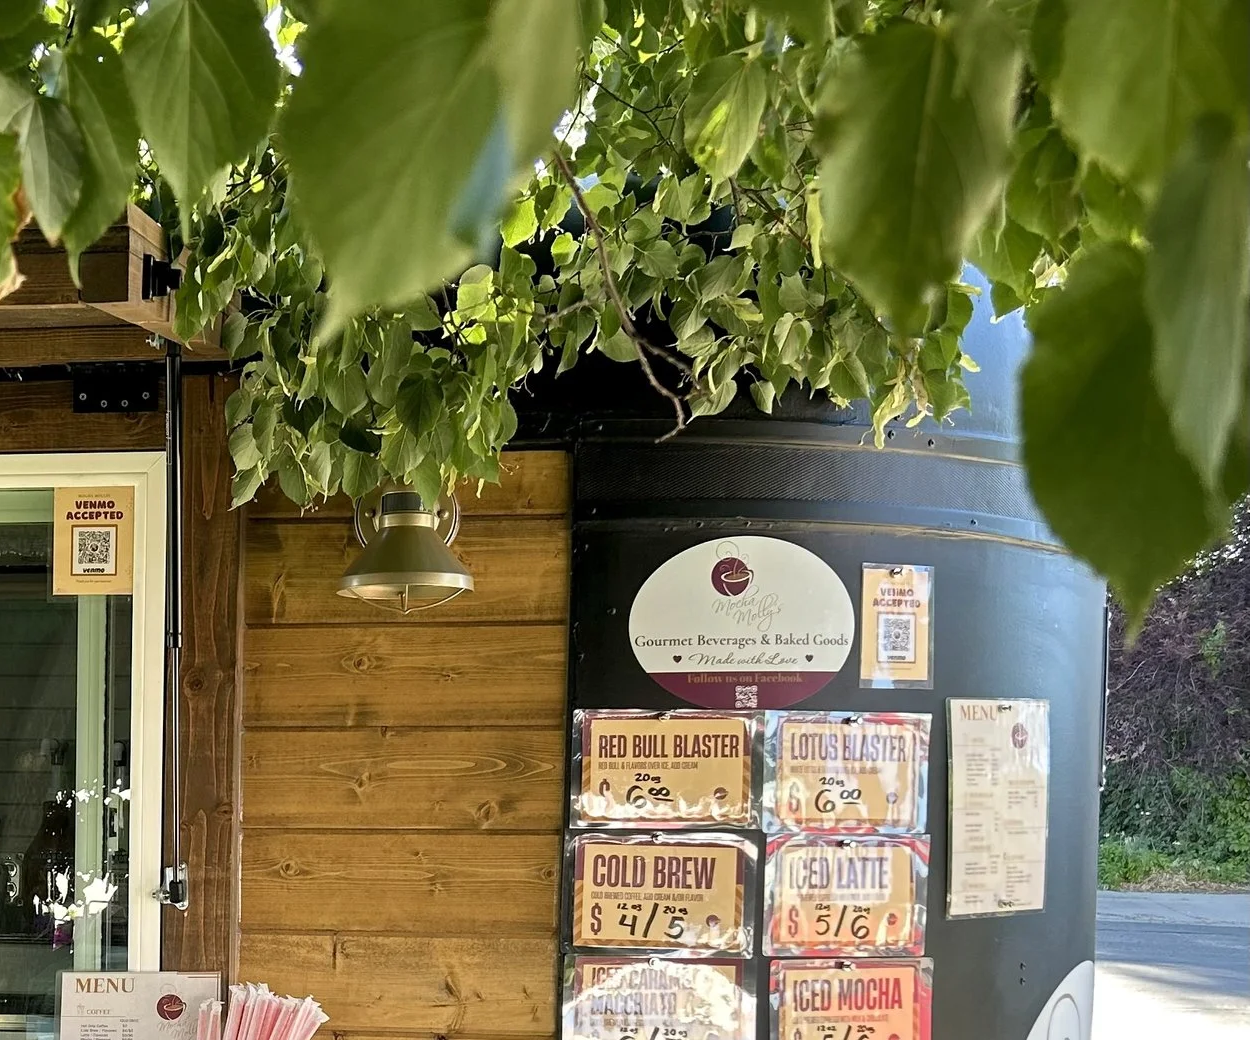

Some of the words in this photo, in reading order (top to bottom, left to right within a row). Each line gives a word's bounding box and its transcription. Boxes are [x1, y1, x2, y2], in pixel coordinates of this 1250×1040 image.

[66, 511, 124, 520] ACCEPTED
[75, 501, 115, 509] VENMO
[712, 585, 759, 614] Mocha
[873, 599, 920, 608] ACCEPTED
[880, 588, 914, 597] VENMO
[733, 593, 783, 632] Molly's
[635, 635, 693, 648] Gourmet
[697, 634, 756, 649] Beverages
[760, 634, 771, 646] &
[775, 633, 809, 646] Baked
[813, 633, 849, 646] Goods
[688, 652, 736, 665] Made
[737, 652, 764, 665] with
[765, 652, 798, 665] Love
[687, 673, 723, 684] Follow
[726, 674, 737, 683] us
[739, 674, 752, 683] on
[755, 673, 802, 683] Facebook
[960, 704, 998, 721] MENU
[599, 734, 627, 758] RED
[632, 734, 668, 758] BULL
[673, 734, 740, 758] BLASTER
[791, 733, 838, 761] LOTUS
[843, 733, 906, 762] BLASTER
[593, 854, 646, 888] COLD
[653, 856, 716, 889] BREW
[790, 857, 830, 890] ICED
[836, 857, 888, 889] LATTE
[590, 902, 602, 935] $
[789, 906, 798, 937] $
[75, 978, 135, 993] MENU
[592, 967, 626, 989] ICE
[793, 979, 831, 1012] ICED
[838, 978, 902, 1011] MOCHA
